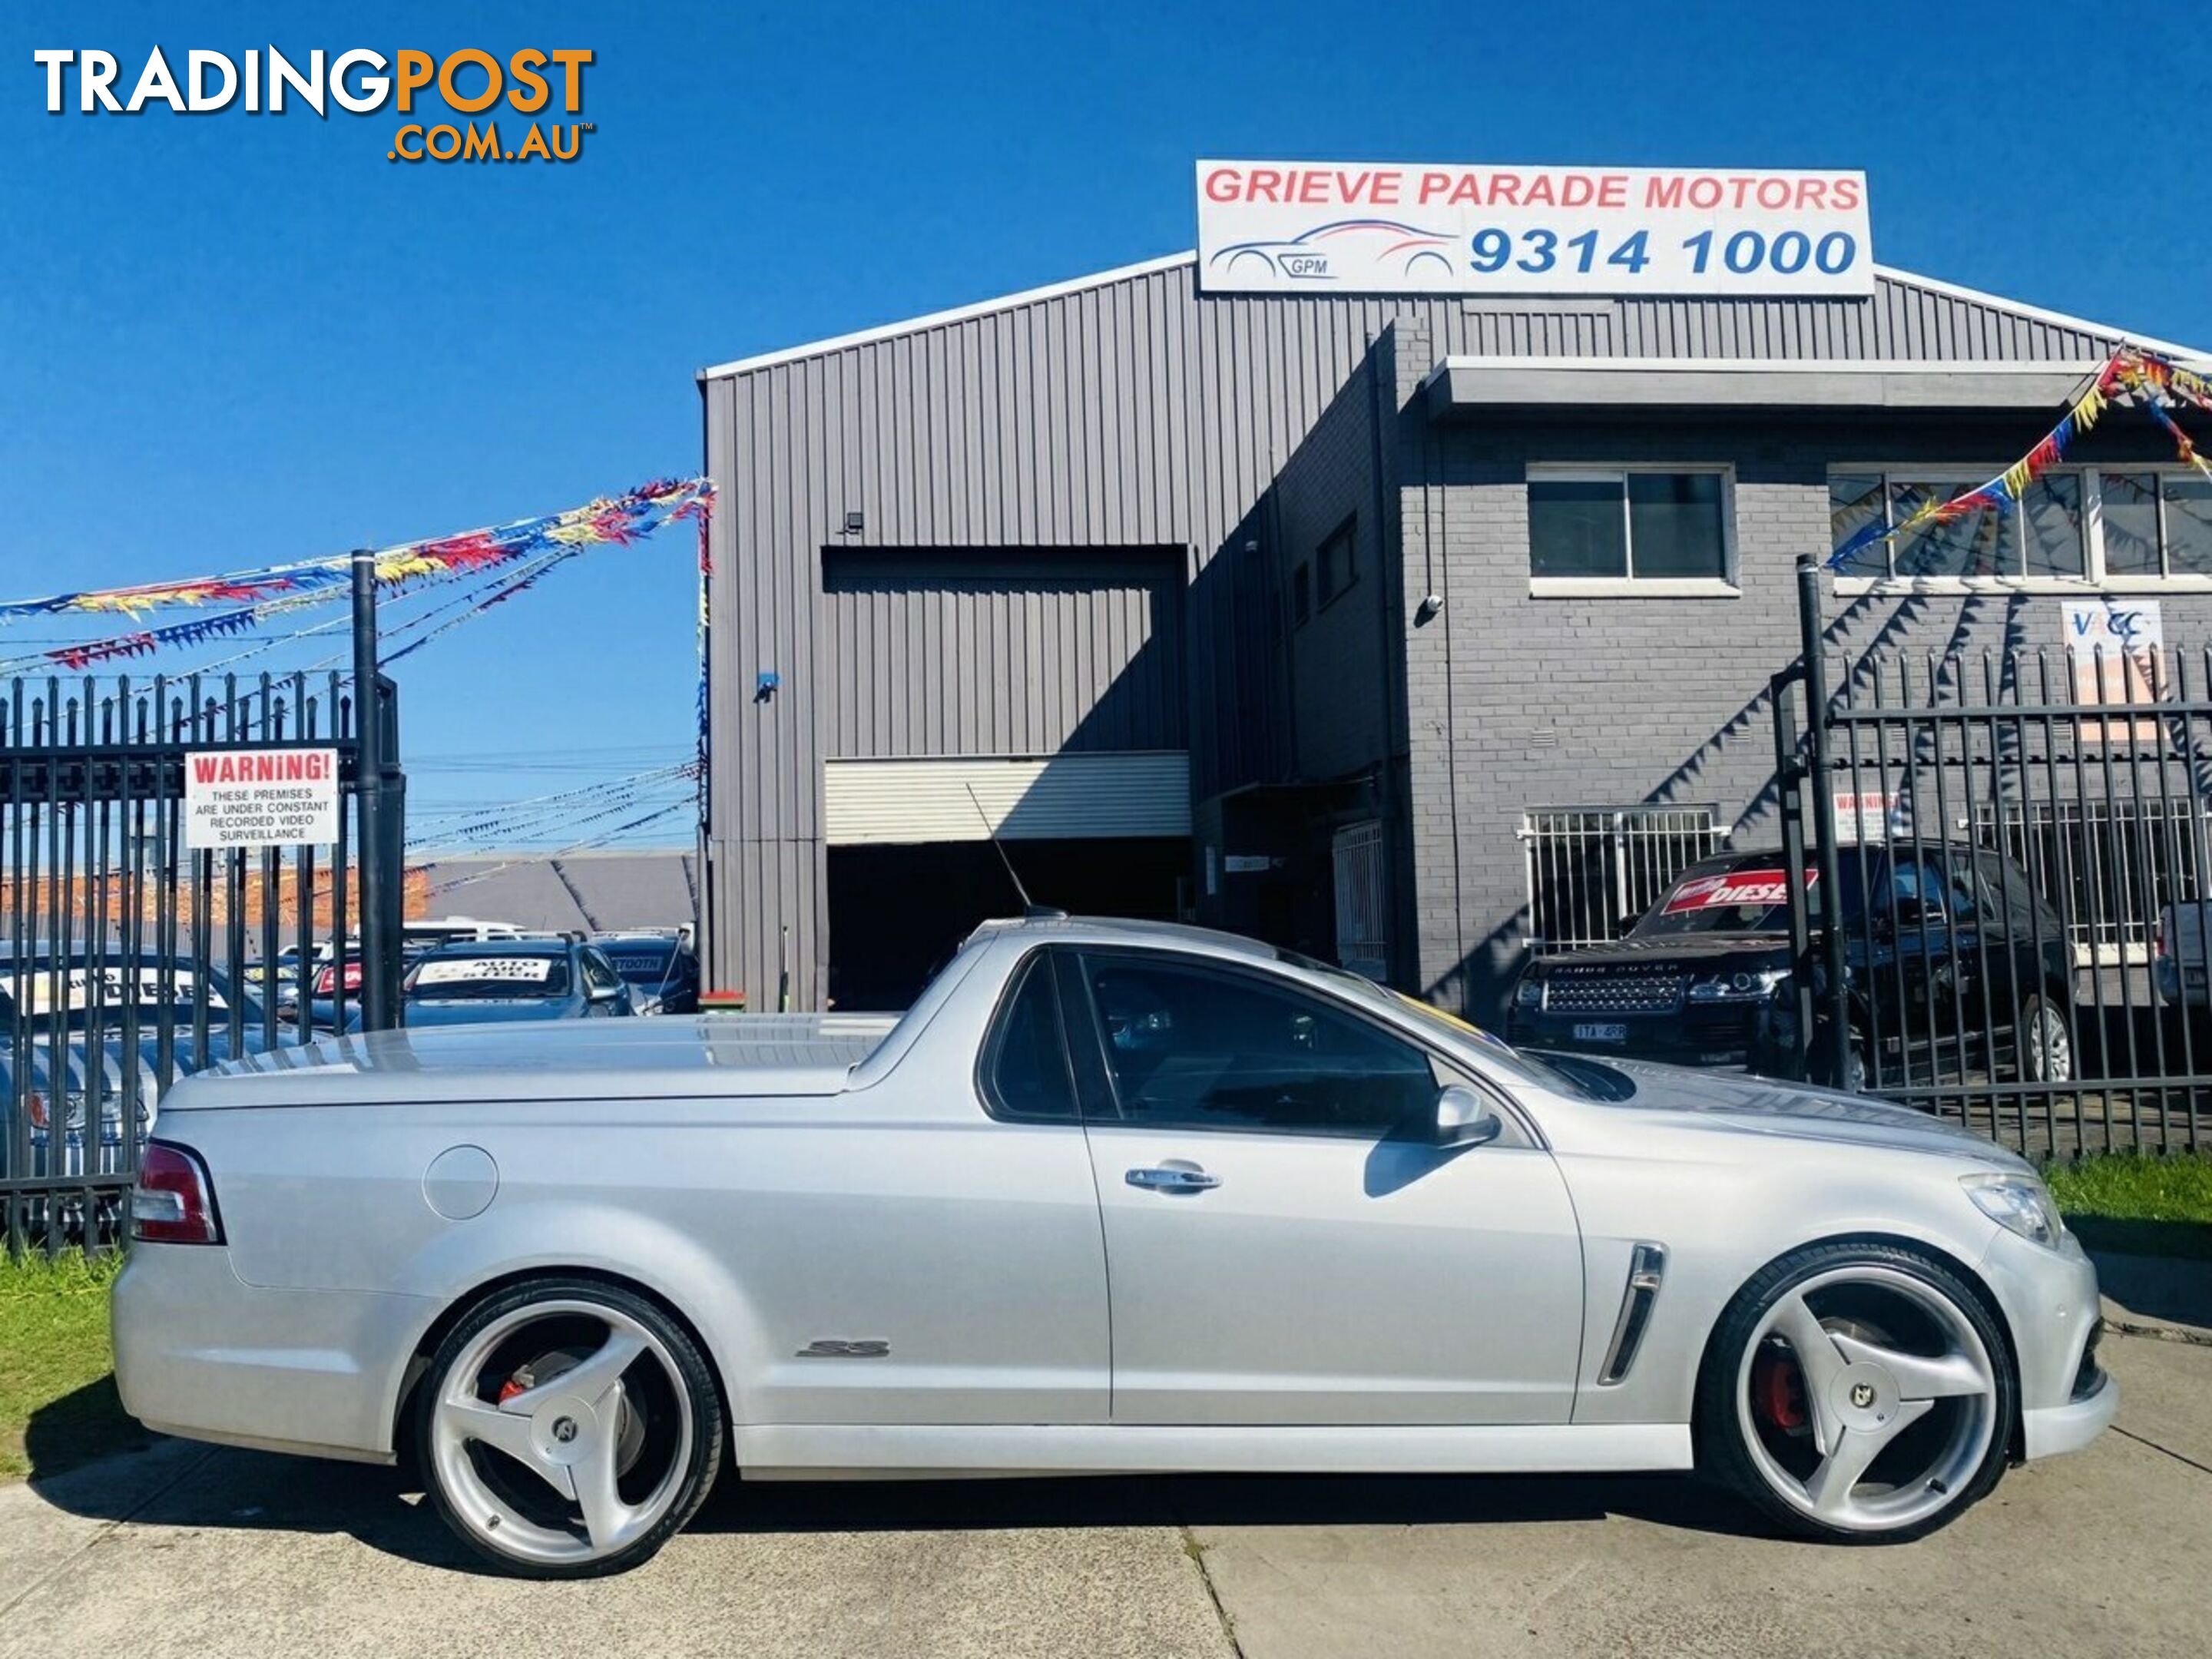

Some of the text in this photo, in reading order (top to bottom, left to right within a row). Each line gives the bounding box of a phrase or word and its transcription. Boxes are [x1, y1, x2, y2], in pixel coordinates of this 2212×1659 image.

[1204, 168, 1859, 211] GRIEVE PARADE MOTORS
[1470, 228, 1856, 274] 9314 1000
[1292, 259, 1327, 273] GPM
[212, 788, 313, 801] THESE PREMISES
[195, 801, 329, 815] ARE UNDER CONSTANT
[210, 814, 314, 828] RECORDED VIDEO
[220, 828, 306, 841] SURVEILLANCE
[1704, 883, 1787, 904] DIESE
